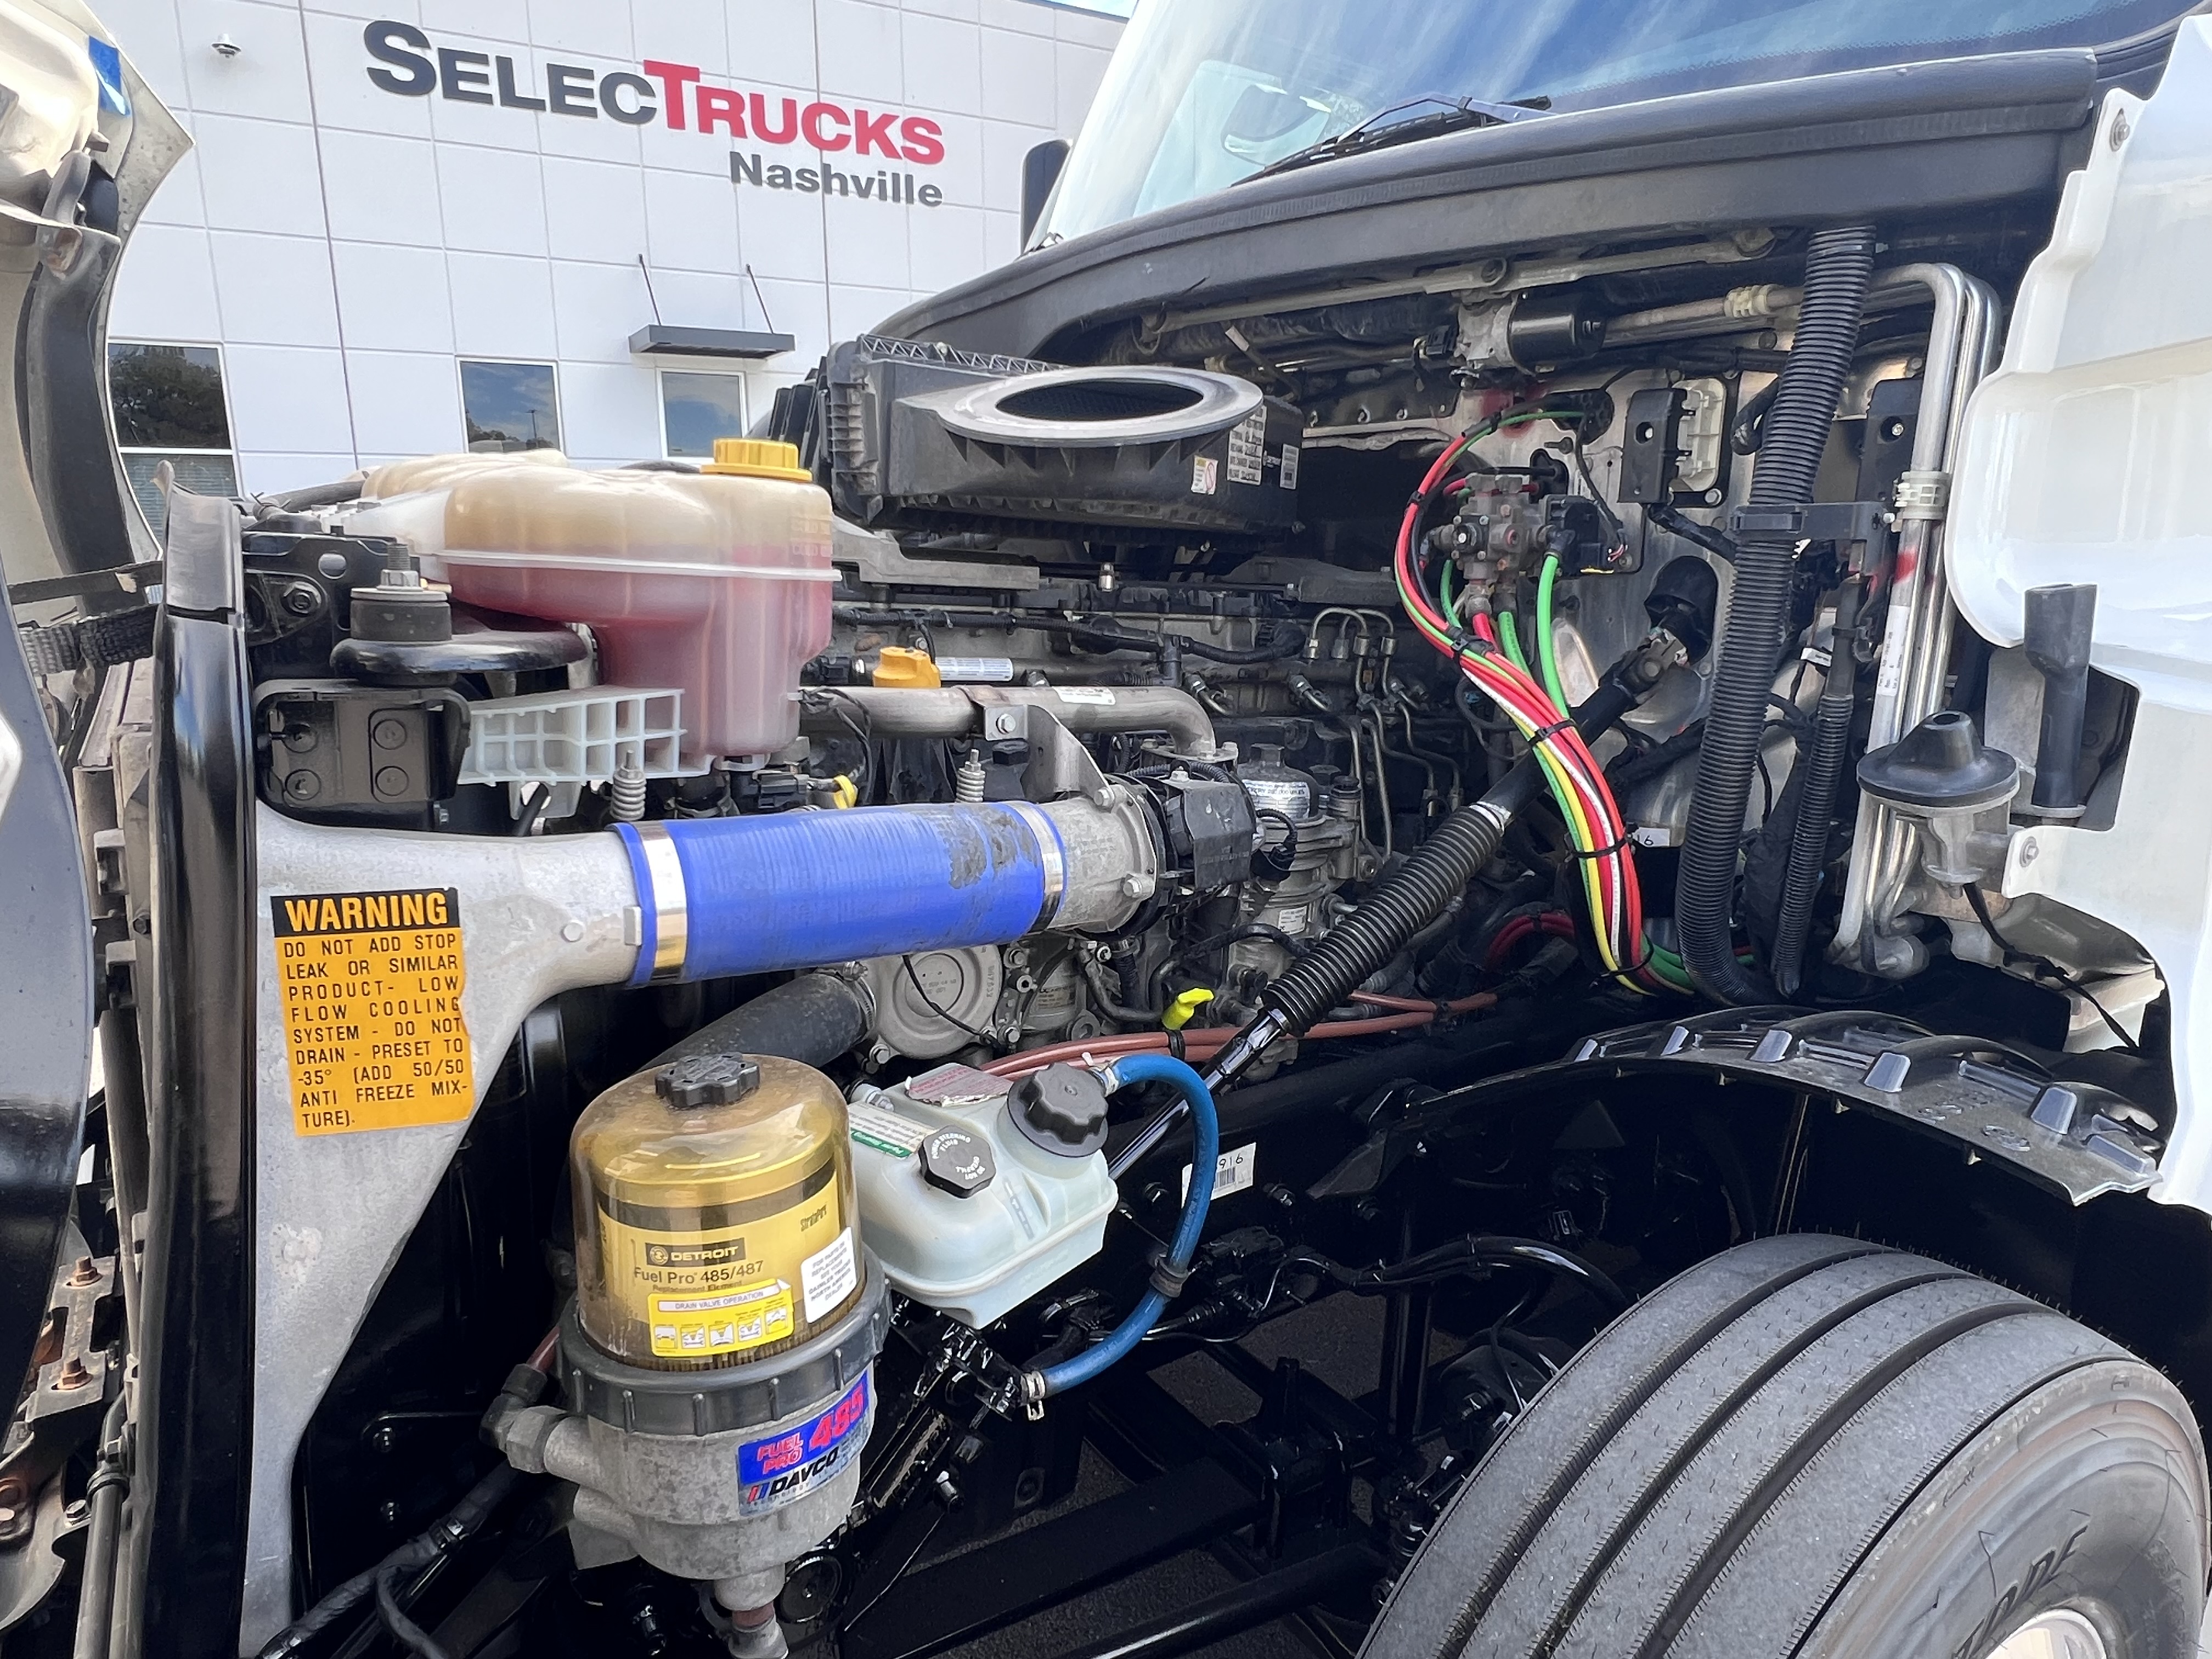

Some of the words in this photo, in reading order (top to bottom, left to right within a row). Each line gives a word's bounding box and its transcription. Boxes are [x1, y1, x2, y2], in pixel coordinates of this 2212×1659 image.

[729, 151, 943, 207] Nashville
[285, 891, 448, 932] WARNING
[284, 941, 306, 957] DO
[321, 939, 353, 956] NOT
[369, 936, 401, 953] ADD
[414, 933, 456, 950] STOP
[286, 962, 329, 979] LEAK
[348, 960, 370, 975] OR
[388, 955, 458, 973] SIMILAR
[419, 975, 458, 992] LOW
[291, 1004, 347, 1023] FLOW
[369, 997, 459, 1017] COOLING
[294, 1025, 359, 1043] SYSTEM
[394, 1021, 415, 1036] DO
[431, 1018, 461, 1034] NOT
[296, 1047, 345, 1065] DRAIN
[372, 1041, 430, 1059] PRESET
[444, 1038, 463, 1053] TO
[413, 1058, 464, 1077] 50/50
[300, 1090, 337, 1107] ANTI
[356, 1084, 414, 1102] FREEZE
[431, 1079, 468, 1096] MIX-
[671, 1245, 739, 1261] DETROIT
[634, 1266, 662, 1283] Fuel
[667, 1272, 695, 1284] Pro
[700, 1260, 764, 1283] 485/487
[699, 1299, 721, 1308] VALVE
[723, 1290, 764, 1305] OPERATION
[757, 1432, 803, 1461] FUEL
[809, 1383, 864, 1451] 485
[763, 1448, 802, 1474] PRO
[769, 1446, 839, 1496] DAVCO
